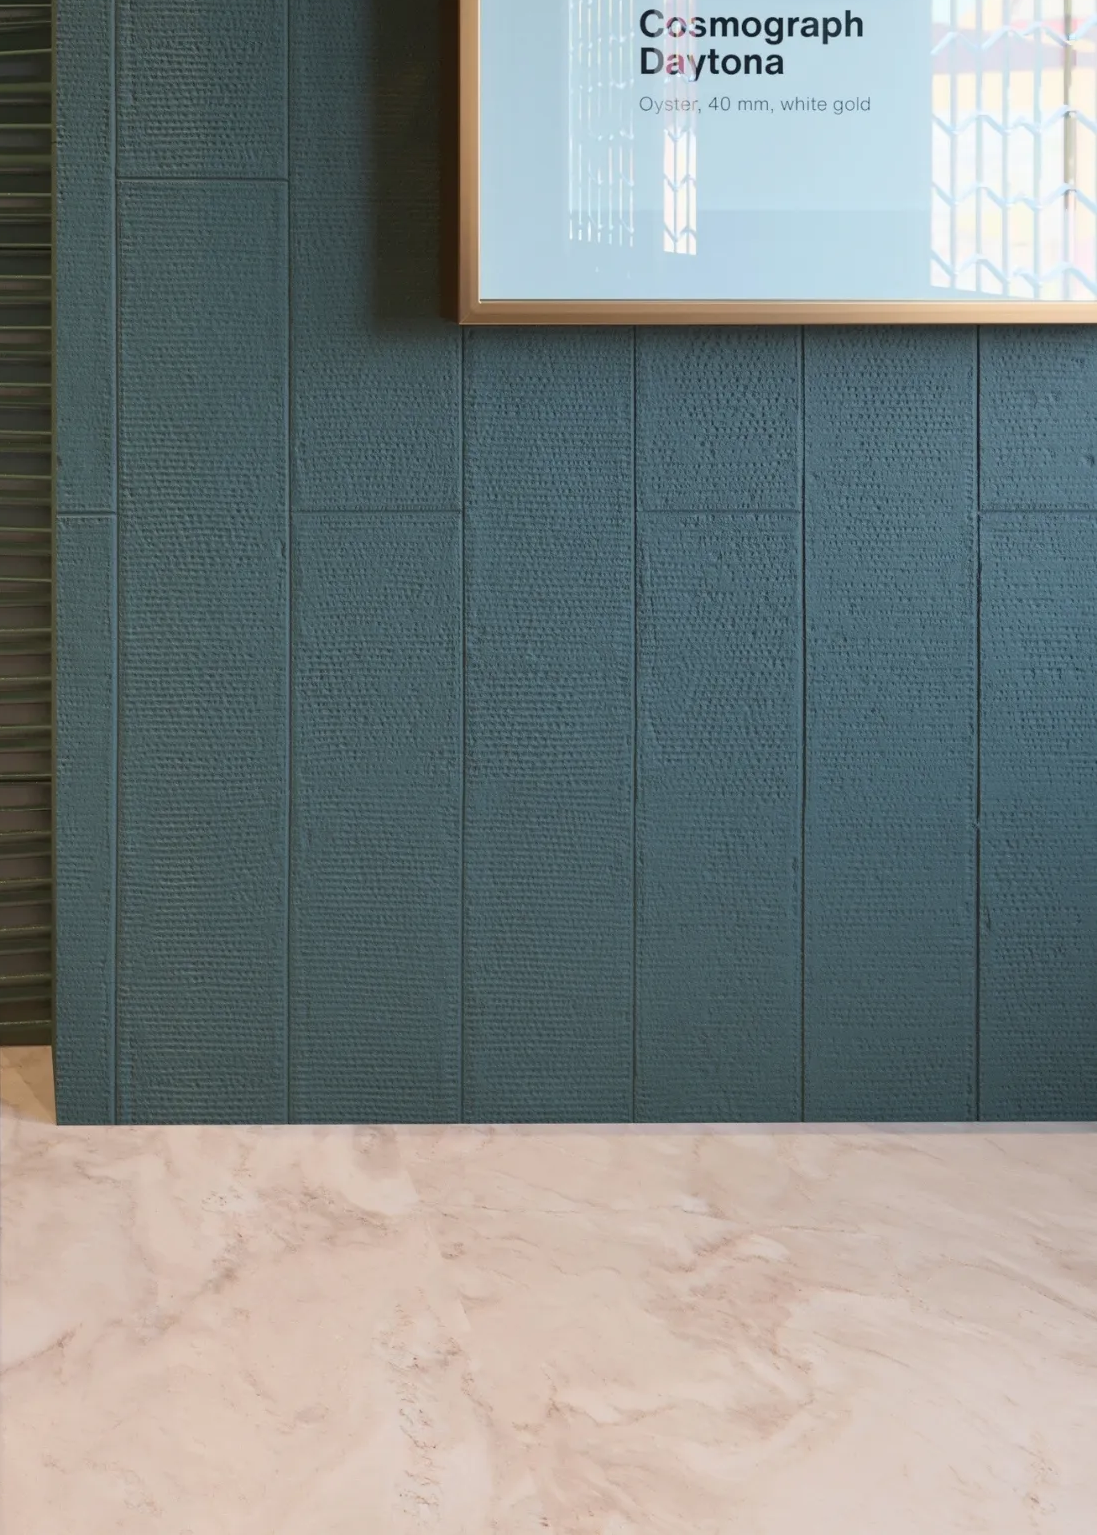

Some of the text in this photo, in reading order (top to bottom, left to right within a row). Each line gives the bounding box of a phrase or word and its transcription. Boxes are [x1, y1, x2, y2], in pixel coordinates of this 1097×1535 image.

[639, 9, 864, 45] Cosmograph
[640, 47, 784, 82] Daytona
[639, 96, 871, 115] Oyster, 40 mm, white gold
